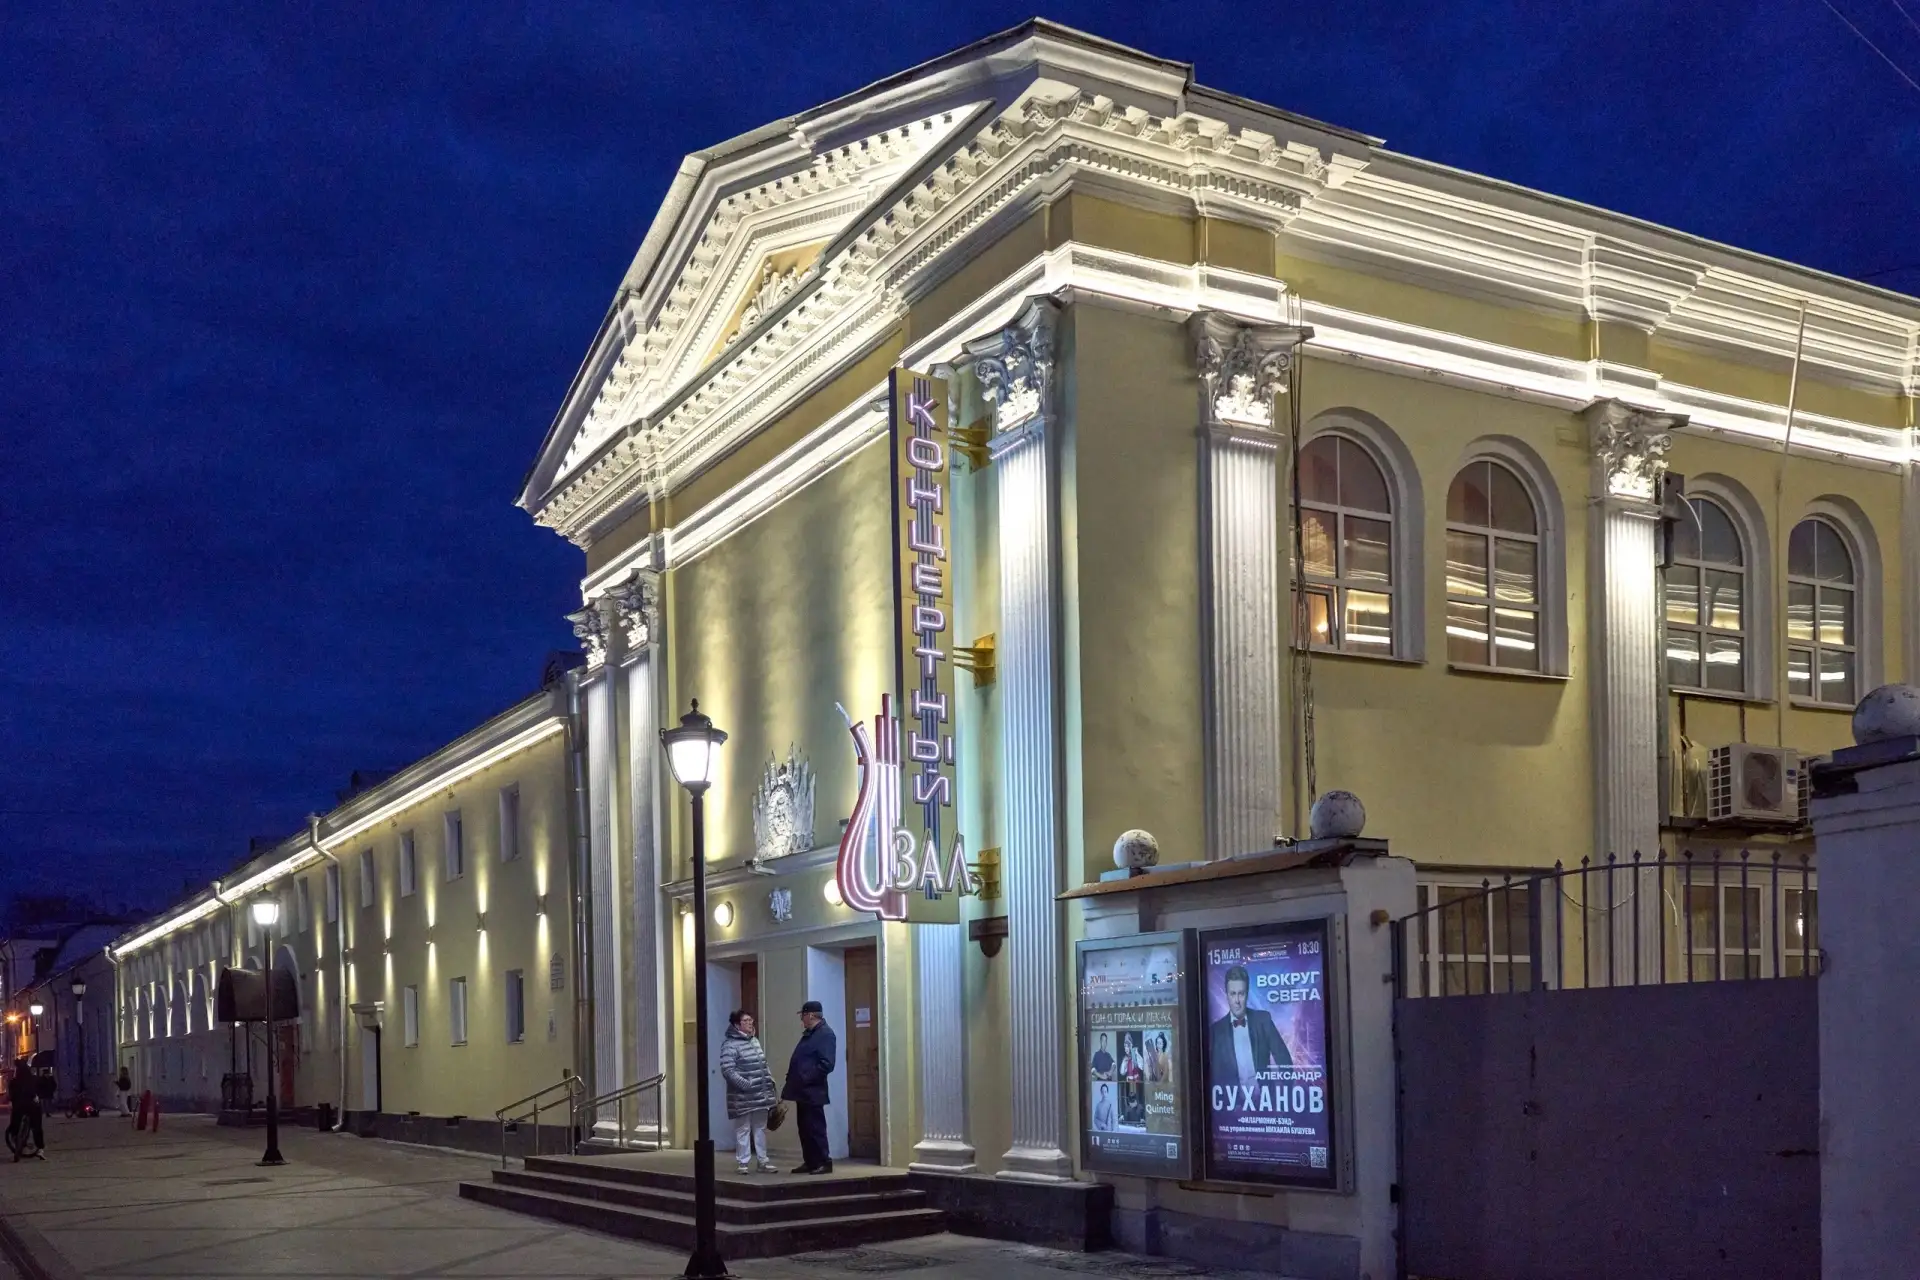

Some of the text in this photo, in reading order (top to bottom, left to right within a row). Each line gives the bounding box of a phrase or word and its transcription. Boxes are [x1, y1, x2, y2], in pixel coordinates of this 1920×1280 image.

[905, 392, 953, 807] КОНЦЕРТНЫЙ
[895, 828, 972, 893] ЗАЛ
[1297, 941, 1320, 955] 18:30
[1208, 949, 1221, 965] 15
[1221, 948, 1241, 960] МАЯ
[1256, 971, 1320, 987] ВОКРУГ
[1267, 988, 1321, 1003] СВЕТА
[1255, 1071, 1322, 1082] АЛЕКСАНДР
[1154, 1091, 1174, 1103] Ming
[1212, 1085, 1324, 1113] СУХАНОВ
[1145, 1104, 1175, 1114] Quintet
